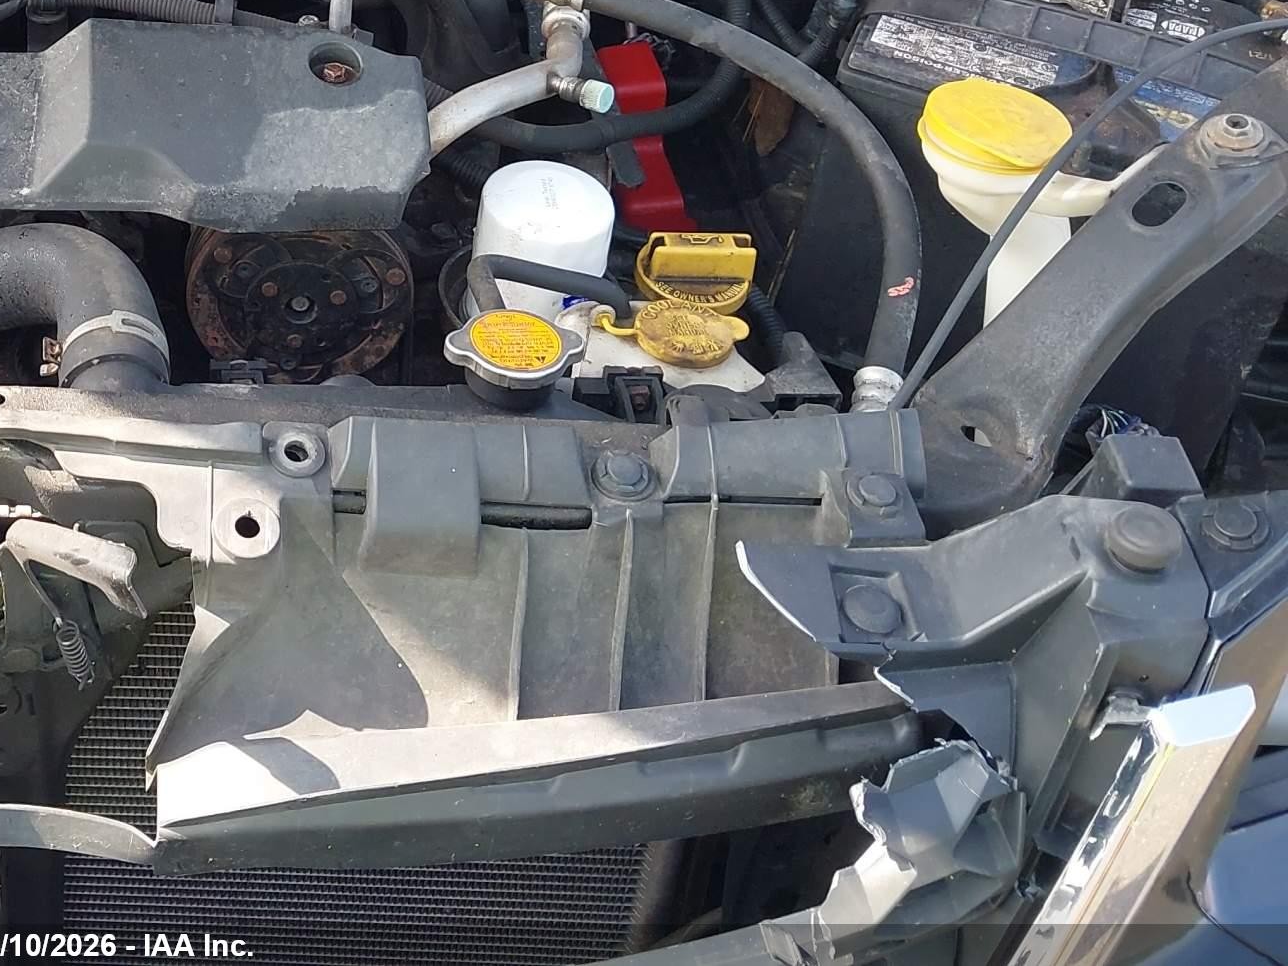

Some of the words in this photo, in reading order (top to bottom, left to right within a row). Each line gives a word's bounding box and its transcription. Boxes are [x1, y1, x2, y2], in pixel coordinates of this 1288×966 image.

[1167, 21, 1199, 37] NAPA
[655, 281, 672, 296] SEE
[673, 290, 715, 303] OWNER'S
[715, 282, 745, 302] MANUAL
[641, 297, 718, 320] COOLANT
